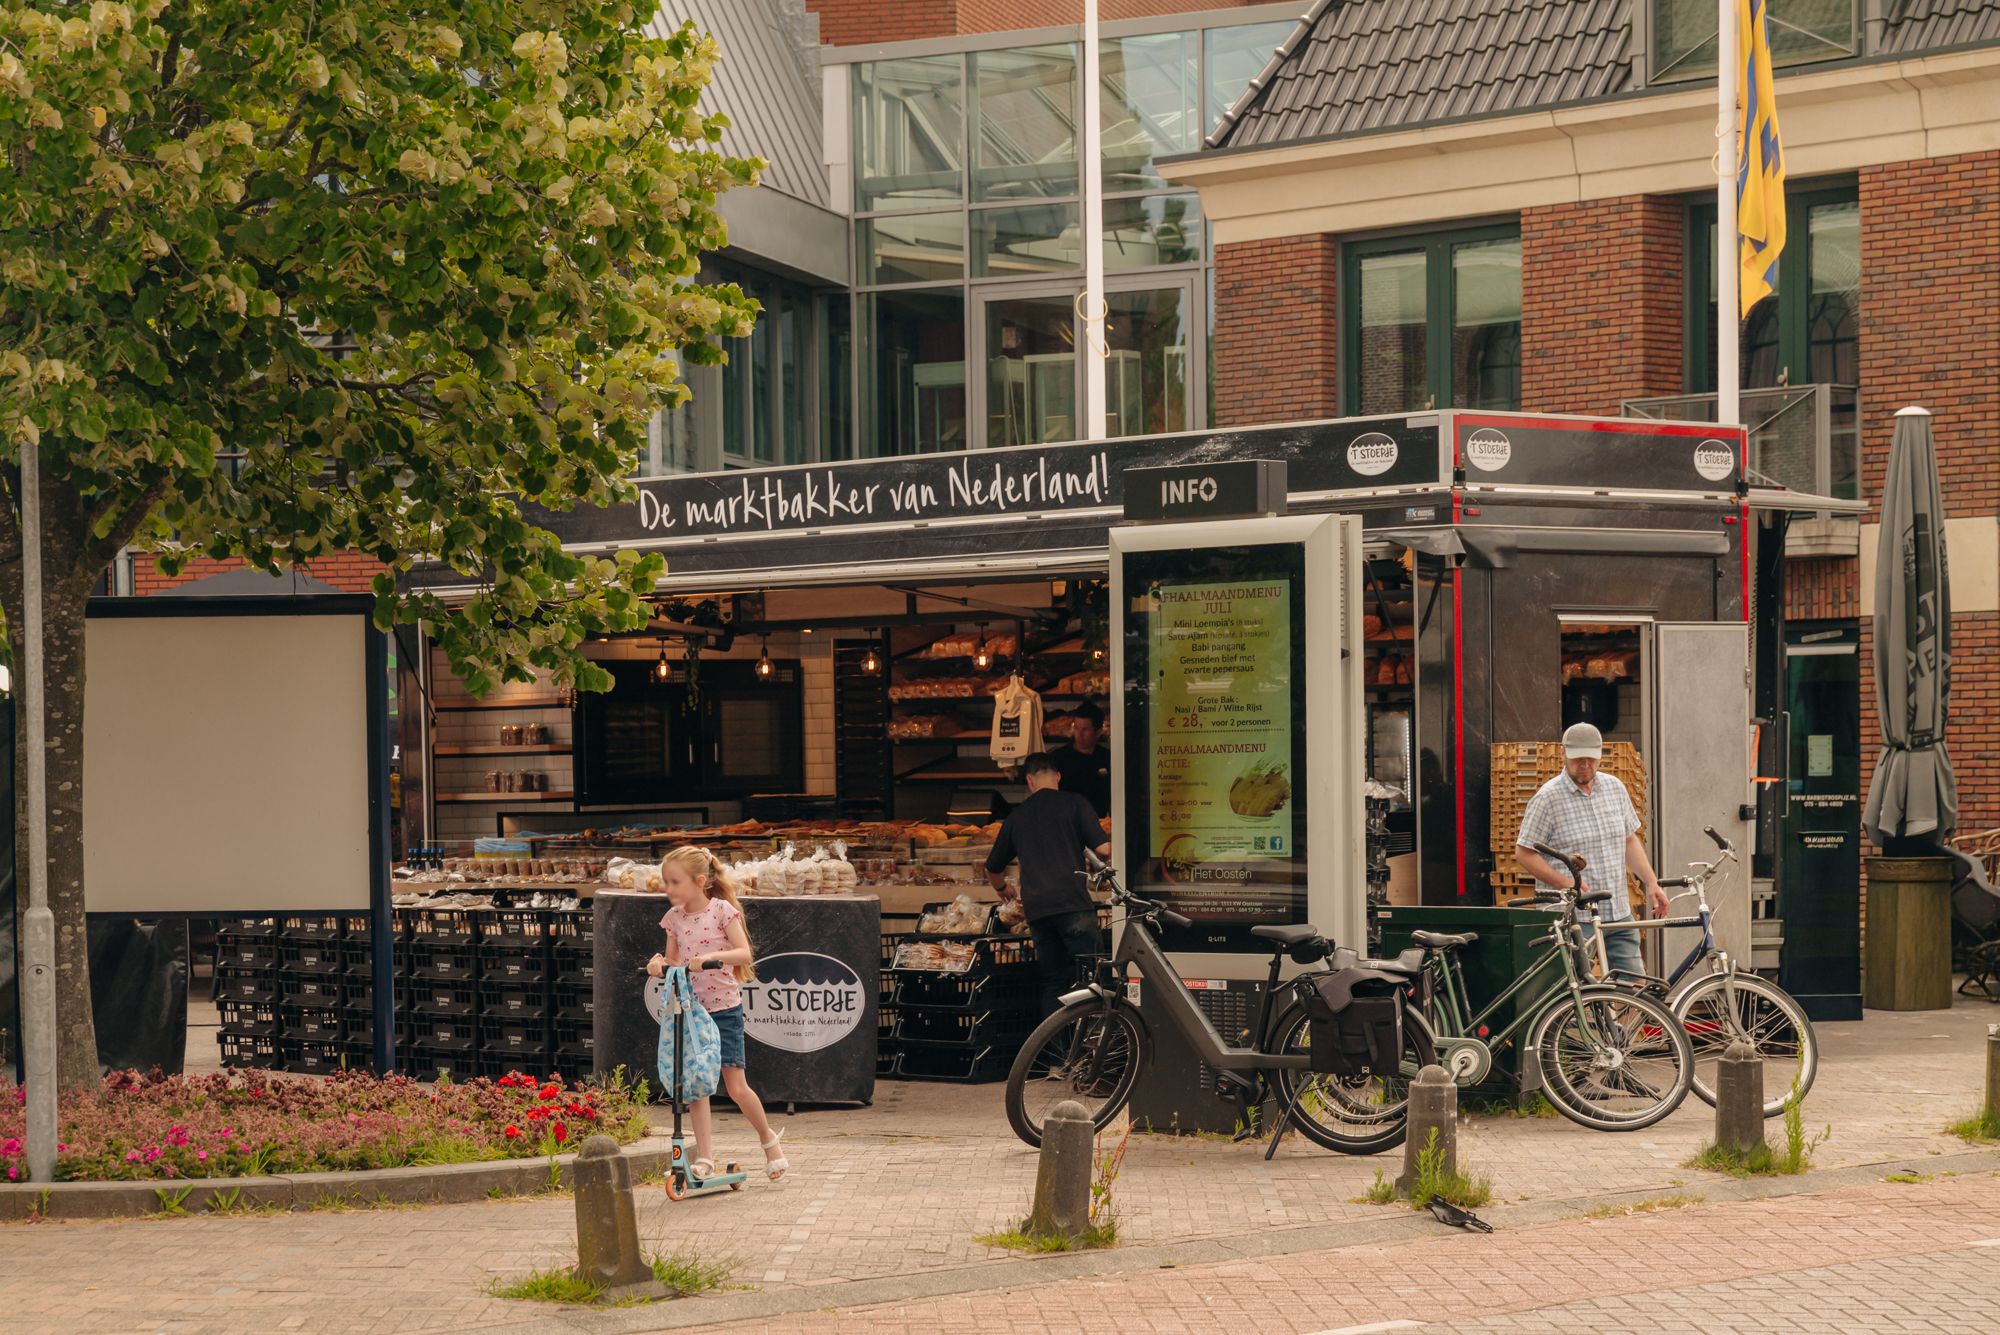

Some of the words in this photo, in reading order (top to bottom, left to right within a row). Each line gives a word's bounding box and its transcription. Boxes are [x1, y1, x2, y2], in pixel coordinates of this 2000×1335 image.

[639, 488, 676, 531] De
[687, 470, 879, 530] marktbakker
[889, 480, 938, 514] van
[948, 451, 1110, 510] Nederland!
[1161, 476, 1218, 507] INFO
[1203, 601, 1233, 615] JULI
[1174, 620, 1192, 628] Mini
[1194, 618, 1234, 630] Loempia's
[1187, 630, 1208, 642] Ajam
[1192, 642, 1210, 652] Babi
[1211, 642, 1246, 652] pangang
[1180, 654, 1220, 665] Gesneden
[1222, 653, 1238, 663] bief
[1239, 654, 1256, 662] met
[1184, 666, 1212, 675] zwarte
[1212, 664, 1254, 675] pepersaus
[1198, 696, 1219, 705] Grote
[1174, 706, 1191, 714] Nasi
[1198, 704, 1217, 713] Bami
[1224, 704, 1244, 712] Witte
[1246, 703, 1263, 712] Rijst
[1212, 720, 1228, 728] voor
[1230, 718, 1236, 726] 2
[1236, 718, 1272, 728] personen
[1156, 743, 1266, 756] AFHAALMAANDMENU
[1156, 760, 1191, 769] ACTIE:
[1194, 868, 1214, 880] Het
[1215, 867, 1252, 880] Oosten
[768, 988, 857, 1012] STOEPJE
[754, 1014, 805, 1026] marktbakker
[818, 1014, 852, 1026] Nederland!
